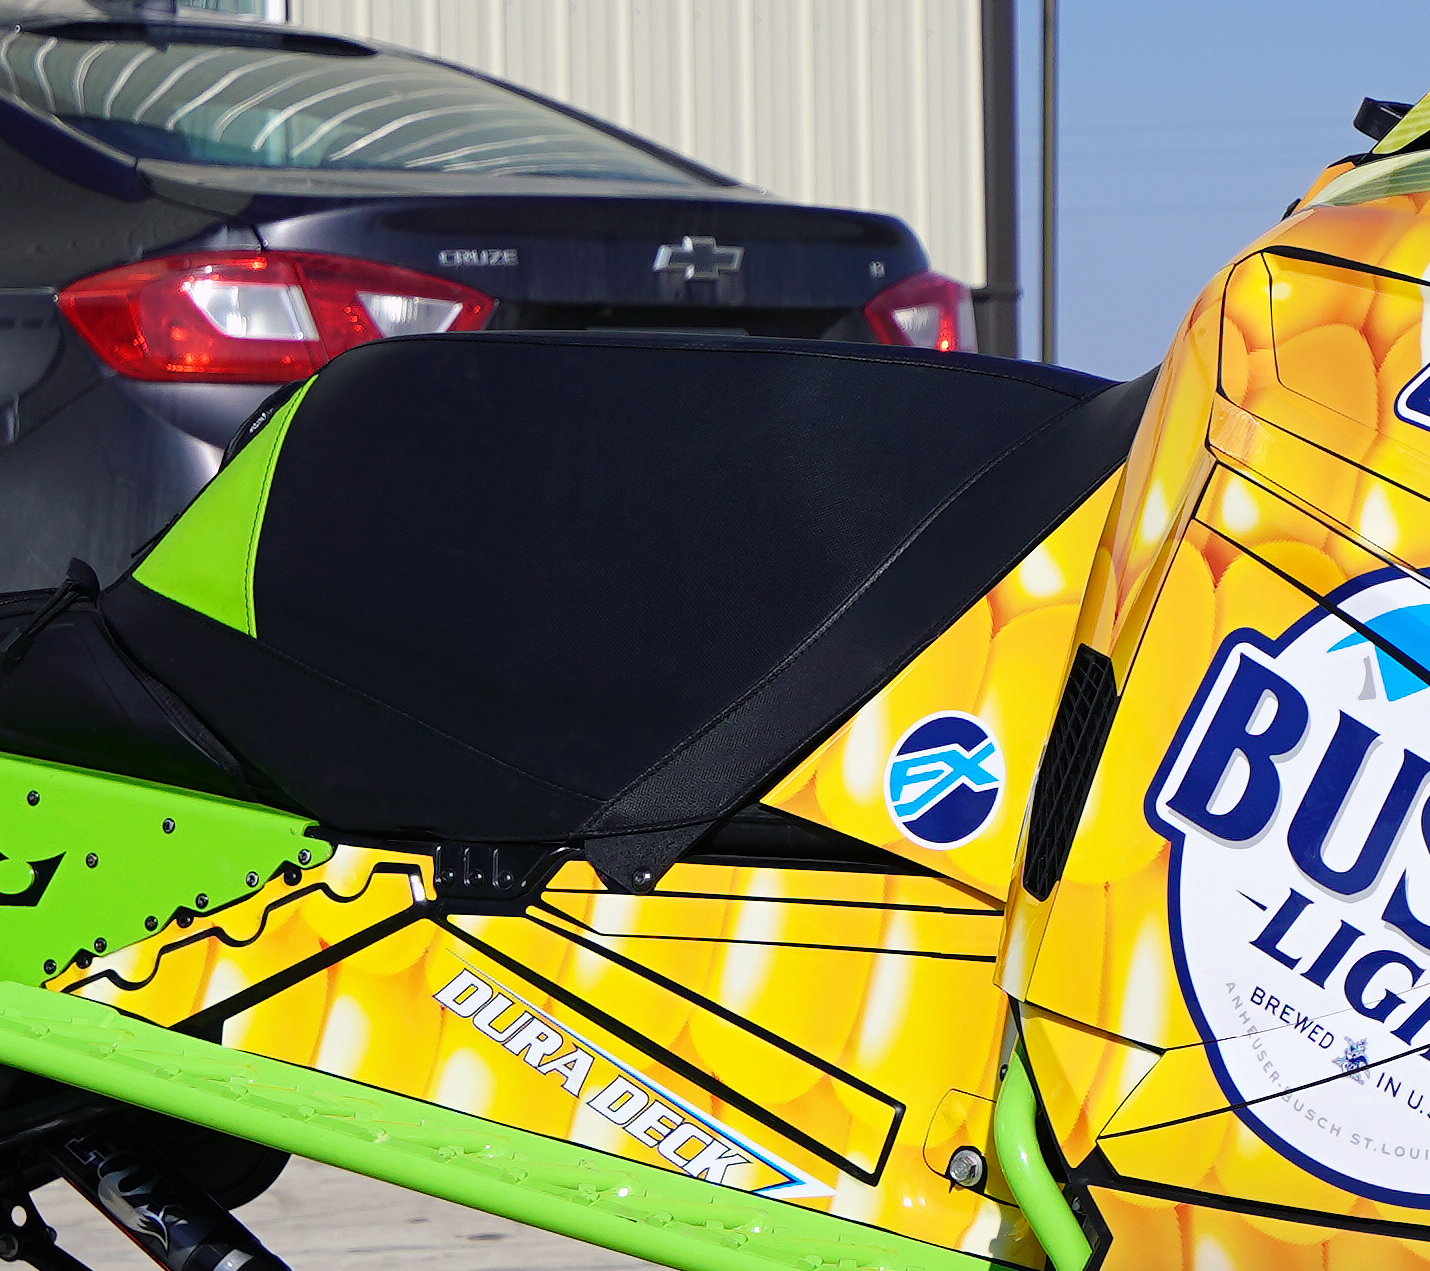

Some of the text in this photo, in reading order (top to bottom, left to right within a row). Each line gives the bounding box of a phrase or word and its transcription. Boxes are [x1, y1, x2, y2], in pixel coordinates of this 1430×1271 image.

[437, 248, 519, 267] CRUZE
[432, 968, 752, 1185] DURA DECK
[1225, 980, 1343, 1138] ANHEUSER-BUSCH
[1250, 986, 1335, 1050] BREWED
[1377, 1072, 1401, 1098] IN
